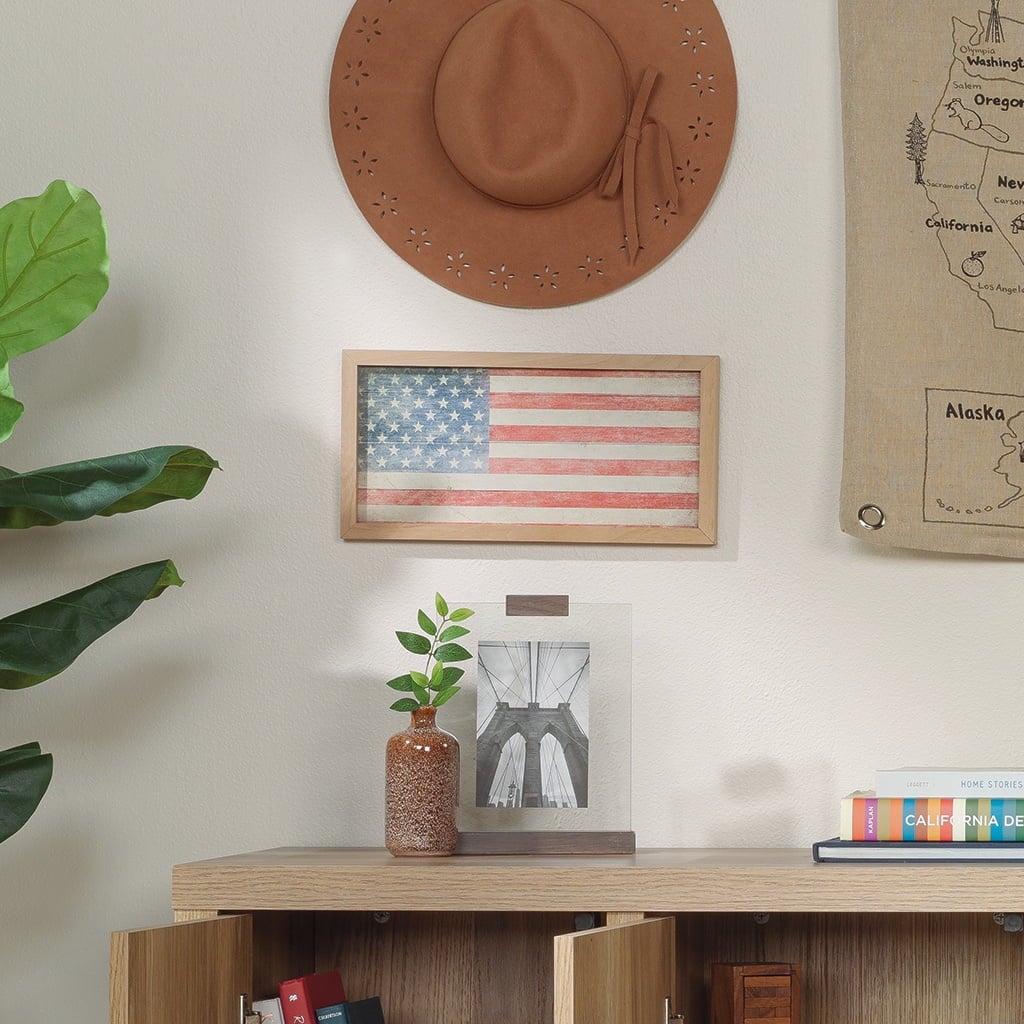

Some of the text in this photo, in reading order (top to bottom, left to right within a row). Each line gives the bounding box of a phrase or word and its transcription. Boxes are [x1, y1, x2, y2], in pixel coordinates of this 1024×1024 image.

[960, 45, 996, 55] Olympia
[953, 80, 982, 90] Salem
[926, 179, 977, 190] Sacramento
[994, 196, 1024, 206] Carson
[925, 218, 994, 233] California
[977, 282, 995, 291] Los
[946, 402, 1005, 421] Alaska
[961, 780, 1024, 789] HOME STORIES
[905, 813, 1000, 828] CALIFORNIA
